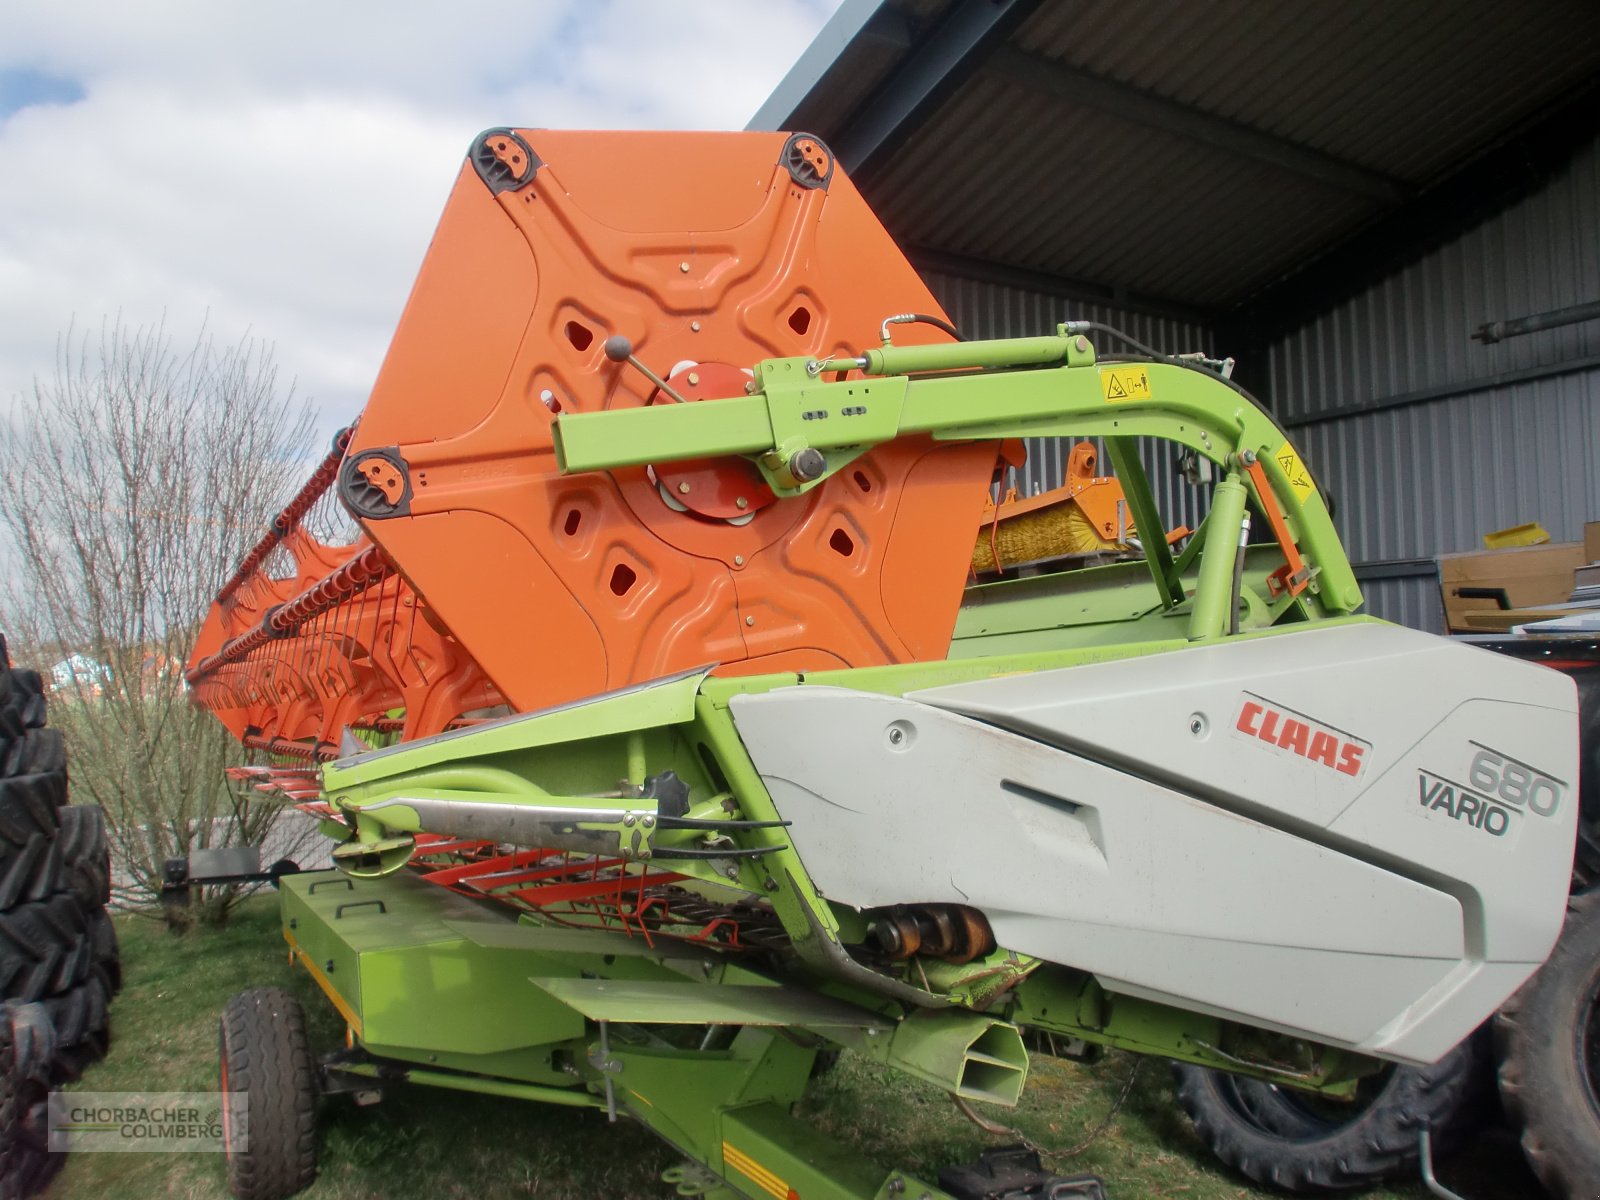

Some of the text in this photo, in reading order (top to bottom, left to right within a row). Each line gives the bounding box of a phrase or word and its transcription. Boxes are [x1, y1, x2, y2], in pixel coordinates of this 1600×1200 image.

[1236, 701, 1364, 777] CLAAS
[1418, 774, 1510, 836] VARIO
[1469, 751, 1561, 817] 680
